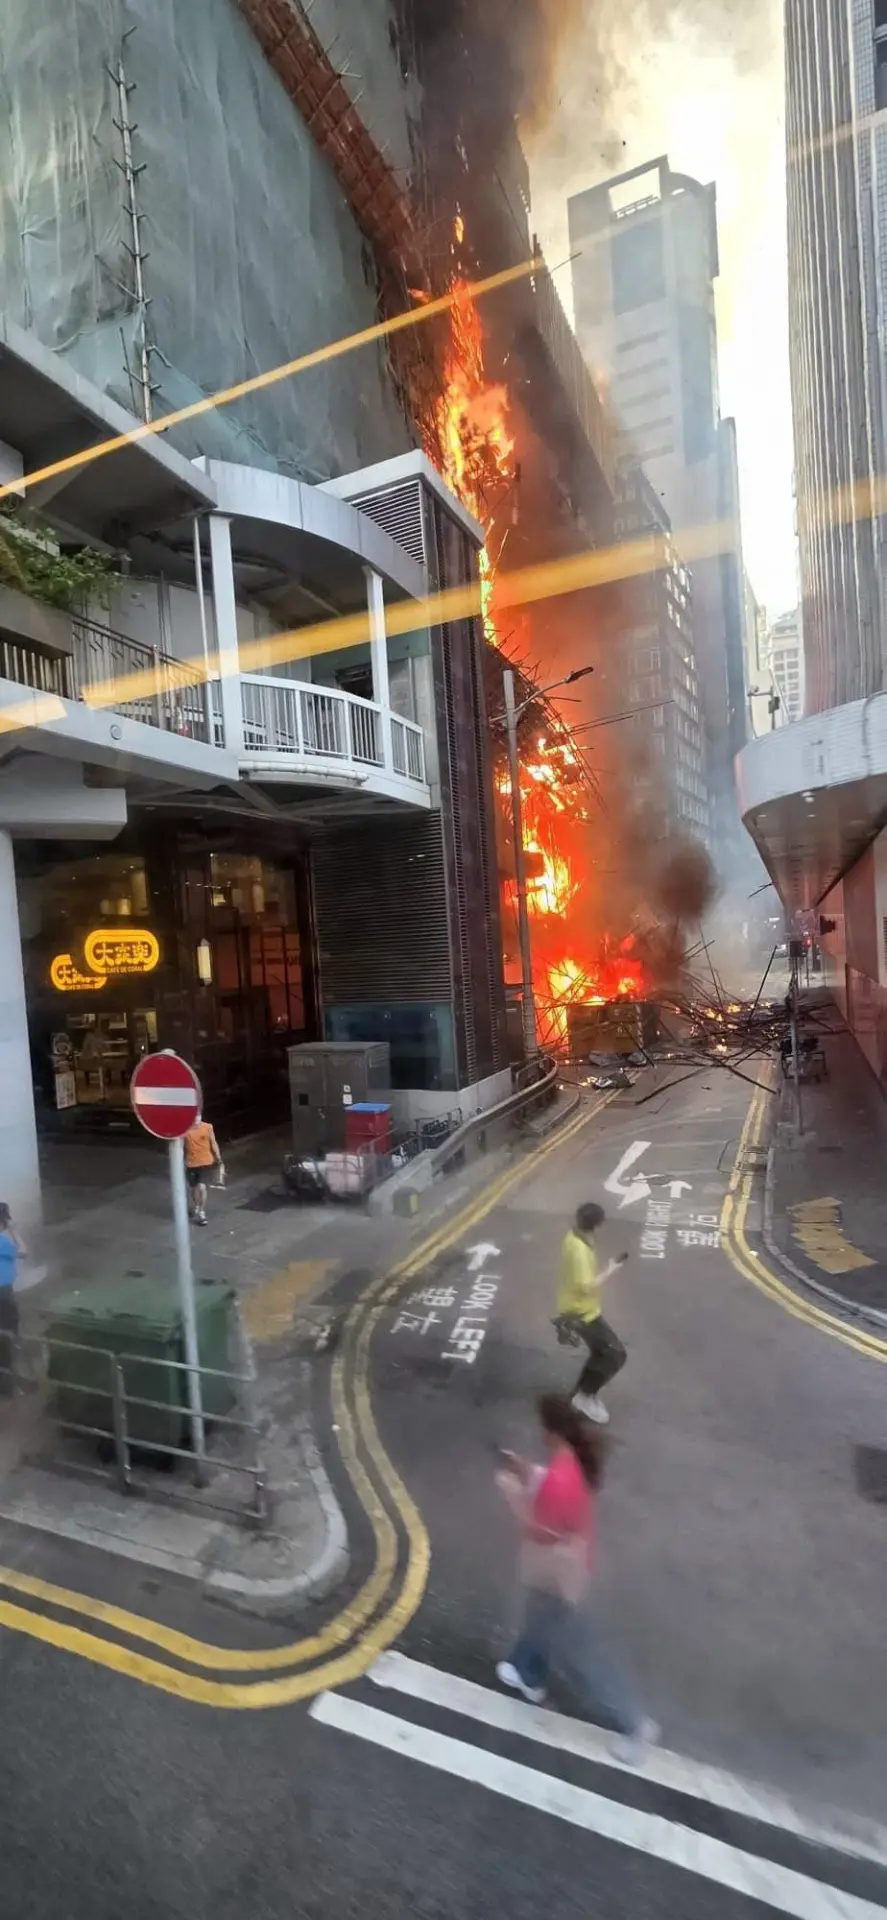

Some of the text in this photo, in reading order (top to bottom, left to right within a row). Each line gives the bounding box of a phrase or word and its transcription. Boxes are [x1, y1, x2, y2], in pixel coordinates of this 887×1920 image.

[95, 941, 150, 966] 大家樂
[640, 1199, 673, 1259] LOOK RIGHT
[676, 1213, 723, 1249] 望右
[390, 1286, 458, 1335] 望左
[440, 1274, 503, 1364] LOOK LEFT
